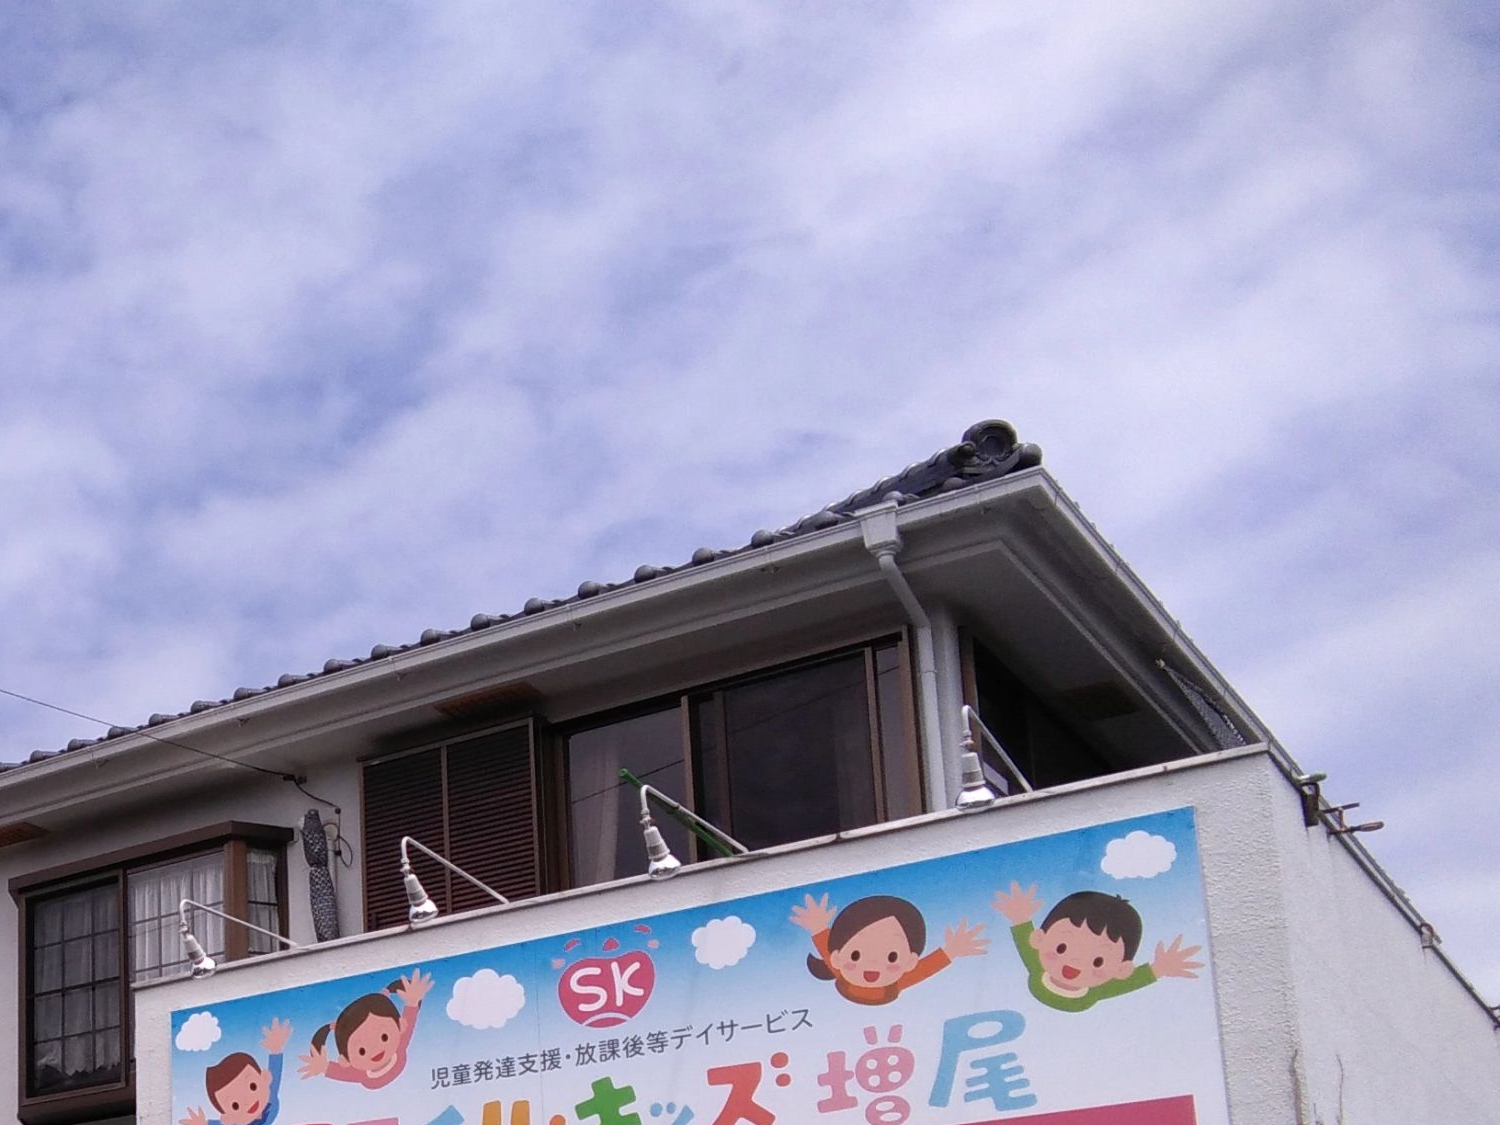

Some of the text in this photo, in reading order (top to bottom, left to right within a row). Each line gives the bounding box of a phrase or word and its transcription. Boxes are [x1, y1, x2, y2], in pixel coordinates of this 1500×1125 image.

[569, 960, 645, 1013] SK
[430, 1007, 813, 1090] 児童発達支援・放課後等デイサービス
